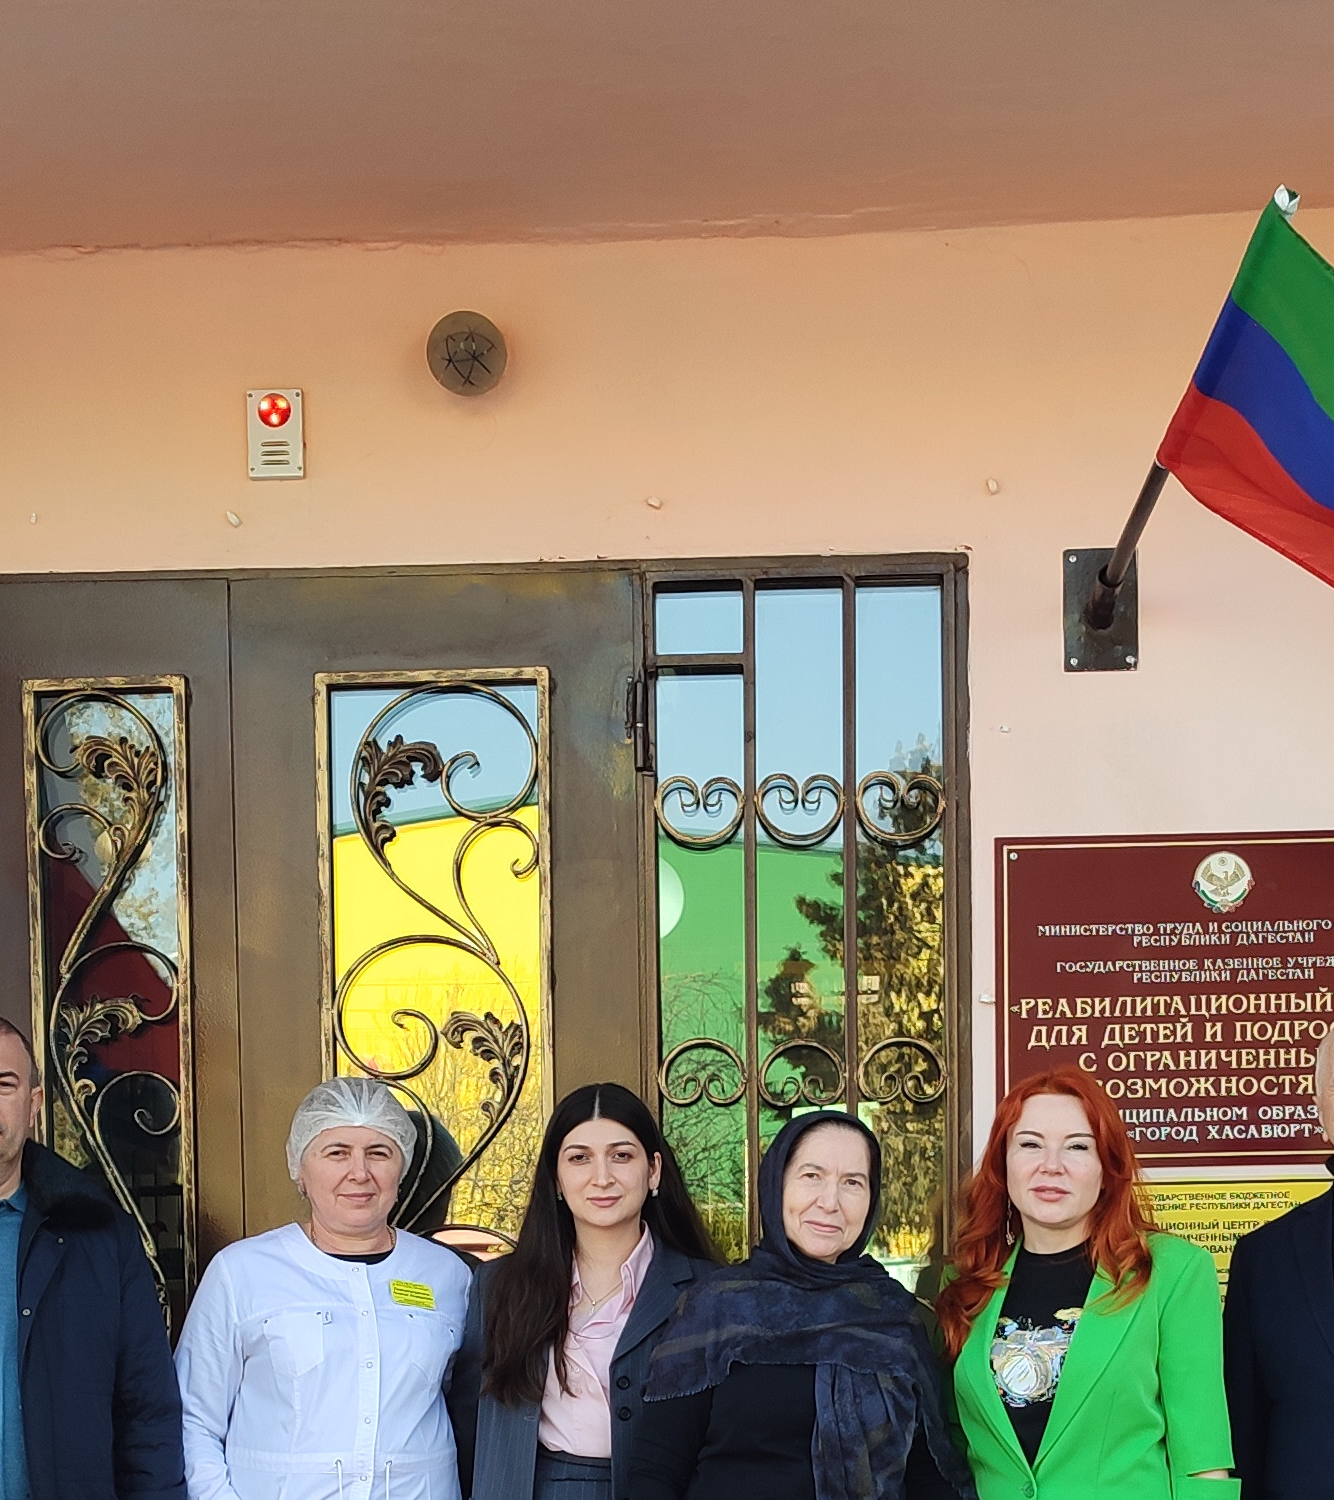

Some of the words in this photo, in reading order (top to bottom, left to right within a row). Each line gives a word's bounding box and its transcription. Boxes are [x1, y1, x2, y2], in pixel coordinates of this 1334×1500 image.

[1037, 923, 1154, 937] МИНИСТЕРСТВО
[1157, 922, 1203, 935] ТРУДА
[1208, 921, 1218, 933] И
[1222, 919, 1332, 934] СОЦИАЛЬНОГО
[1133, 933, 1230, 947] РЕСПУБЛИКИ
[1235, 931, 1314, 946] ДАГЕСТАН
[1056, 959, 1198, 973] ГОСУДАРСТВЕННОЕ
[1204, 957, 1283, 971] КАЗЕННОЕ
[1133, 970, 1230, 984] РЕСПУБЛИКИ
[1236, 968, 1314, 983] ДАГЕСТАН
[1009, 987, 1333, 1019] «РЕАБИЛИТАЦИОННЫЙ
[1027, 1024, 1088, 1051] ДЛЯ
[1100, 1016, 1194, 1049] ДЕТЕЙ
[1204, 1021, 1223, 1042] И
[1078, 1052, 1098, 1072] С
[1107, 1048, 1319, 1072] ОГРАНИЧЕННЫ
[1095, 1074, 1315, 1099] ОЗМОЖНОСТЯ
[1119, 1106, 1248, 1124] ЦИПАЛЬНОМ
[1126, 1127, 1199, 1143] «ГОРОД
[1207, 1124, 1325, 1140] ХАСАВЮРТ»
